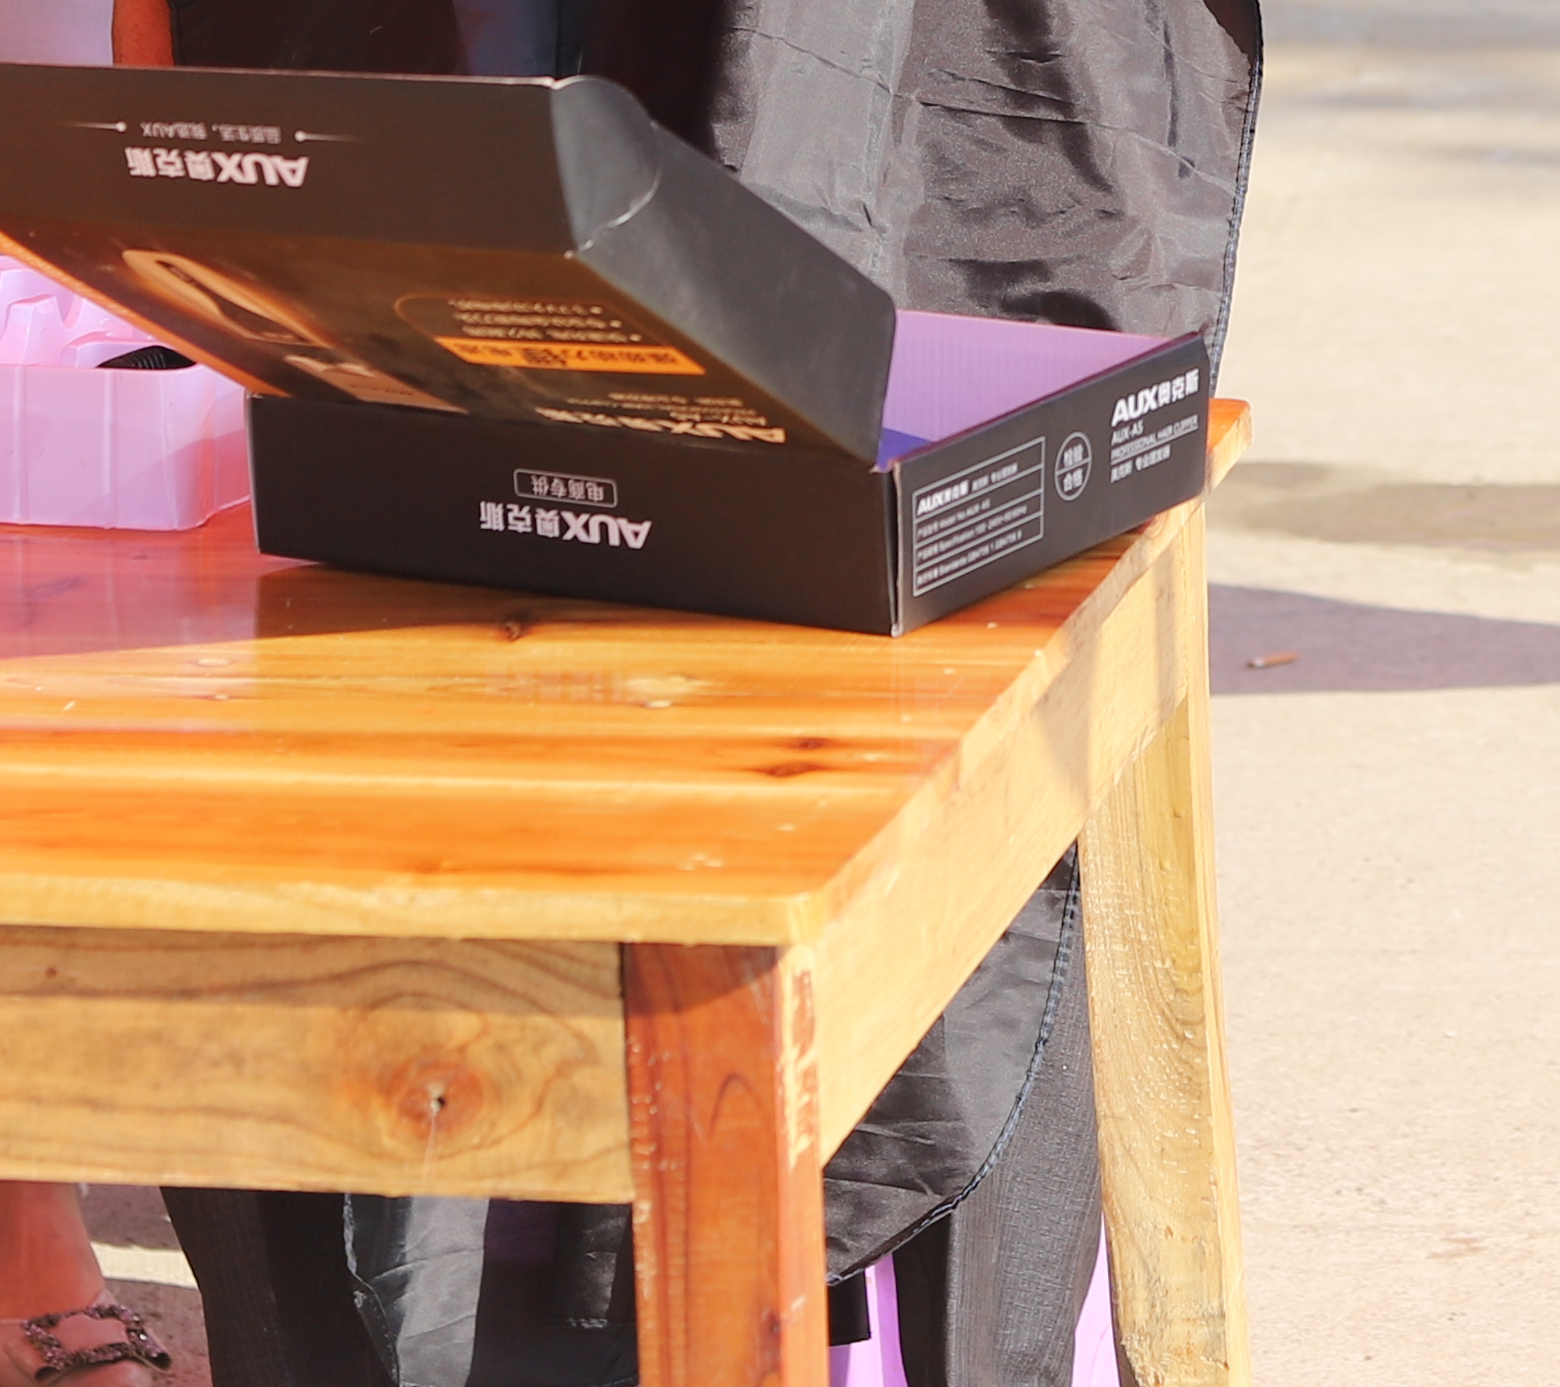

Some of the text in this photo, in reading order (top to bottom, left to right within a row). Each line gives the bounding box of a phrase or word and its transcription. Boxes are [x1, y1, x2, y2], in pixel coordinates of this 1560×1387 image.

[125, 147, 309, 189] AUX奥克斯
[1111, 368, 1200, 427] AUX奥克斯
[531, 475, 605, 502] 电商专供
[479, 501, 653, 549] AUX奥克斯
